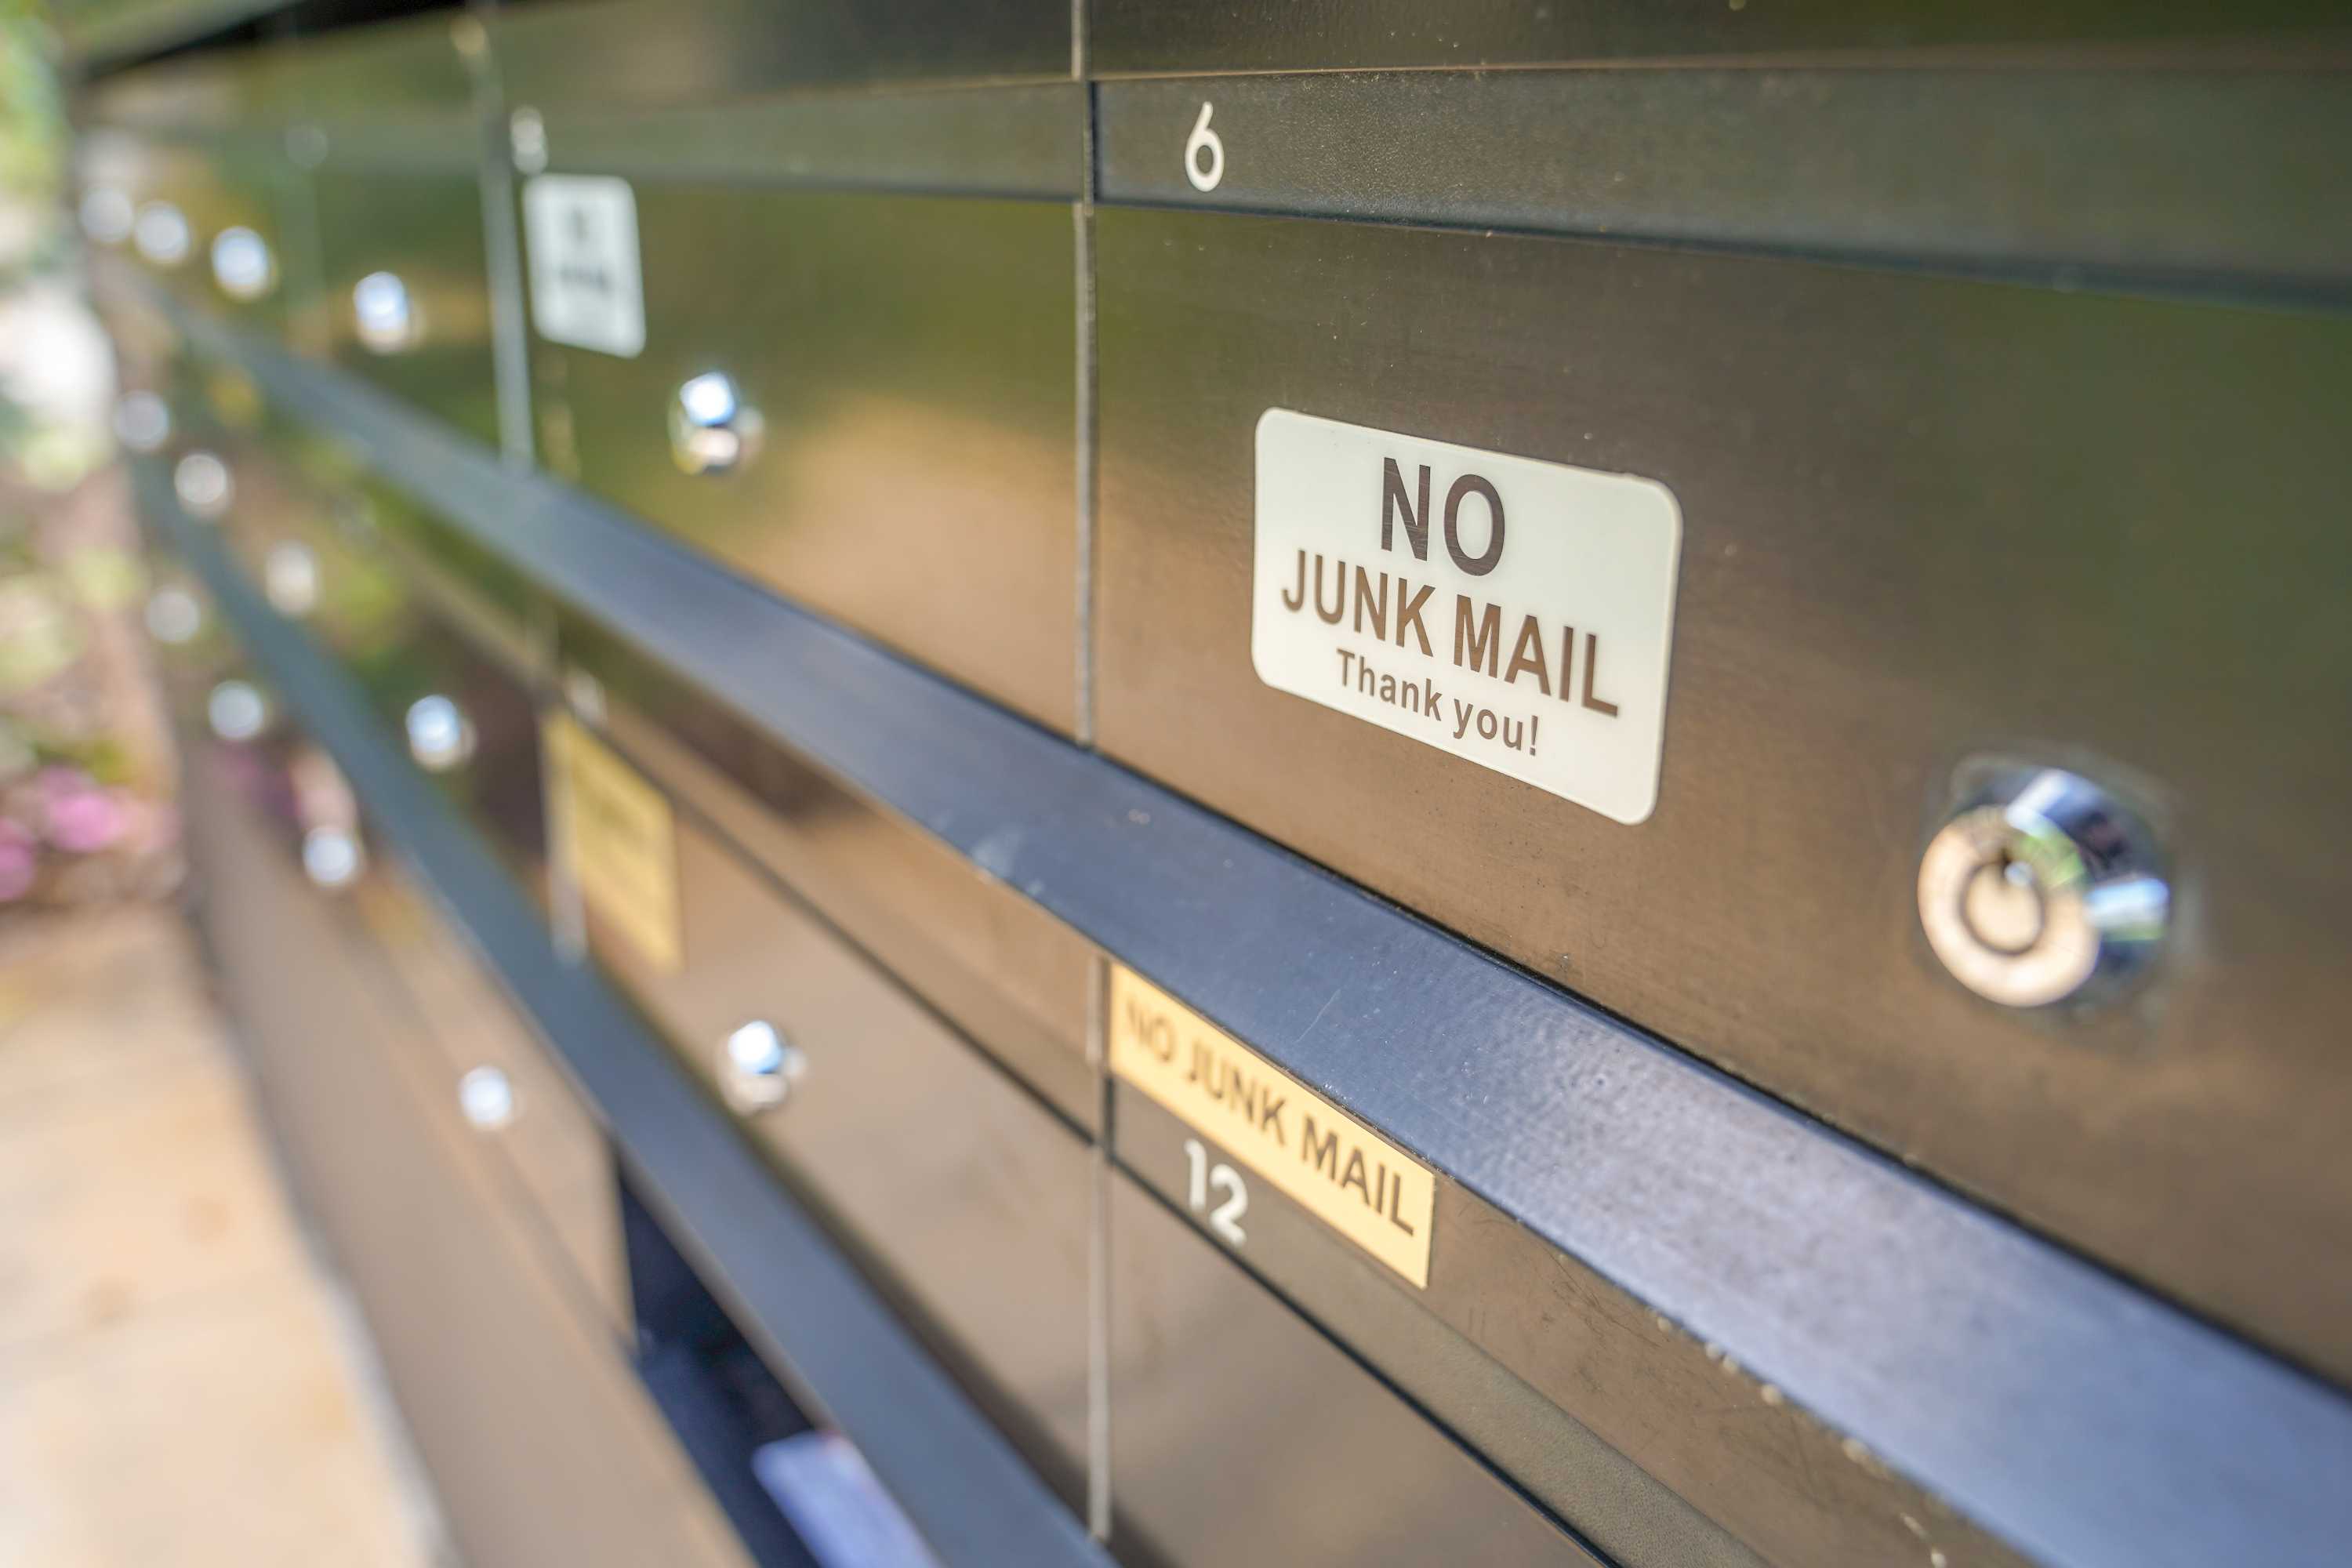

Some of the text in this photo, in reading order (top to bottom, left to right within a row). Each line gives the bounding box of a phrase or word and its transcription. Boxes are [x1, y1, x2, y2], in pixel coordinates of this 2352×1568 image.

[1185, 101, 1225, 192] 6
[1381, 456, 1505, 576] NO
[1281, 549, 1619, 718] JUNK MAIL
[1337, 648, 1539, 756] Thank you!
[1184, 1036, 1286, 1147] JUNK
[1301, 1113, 1414, 1237] MAIL
[1184, 1138, 1249, 1248] 12
